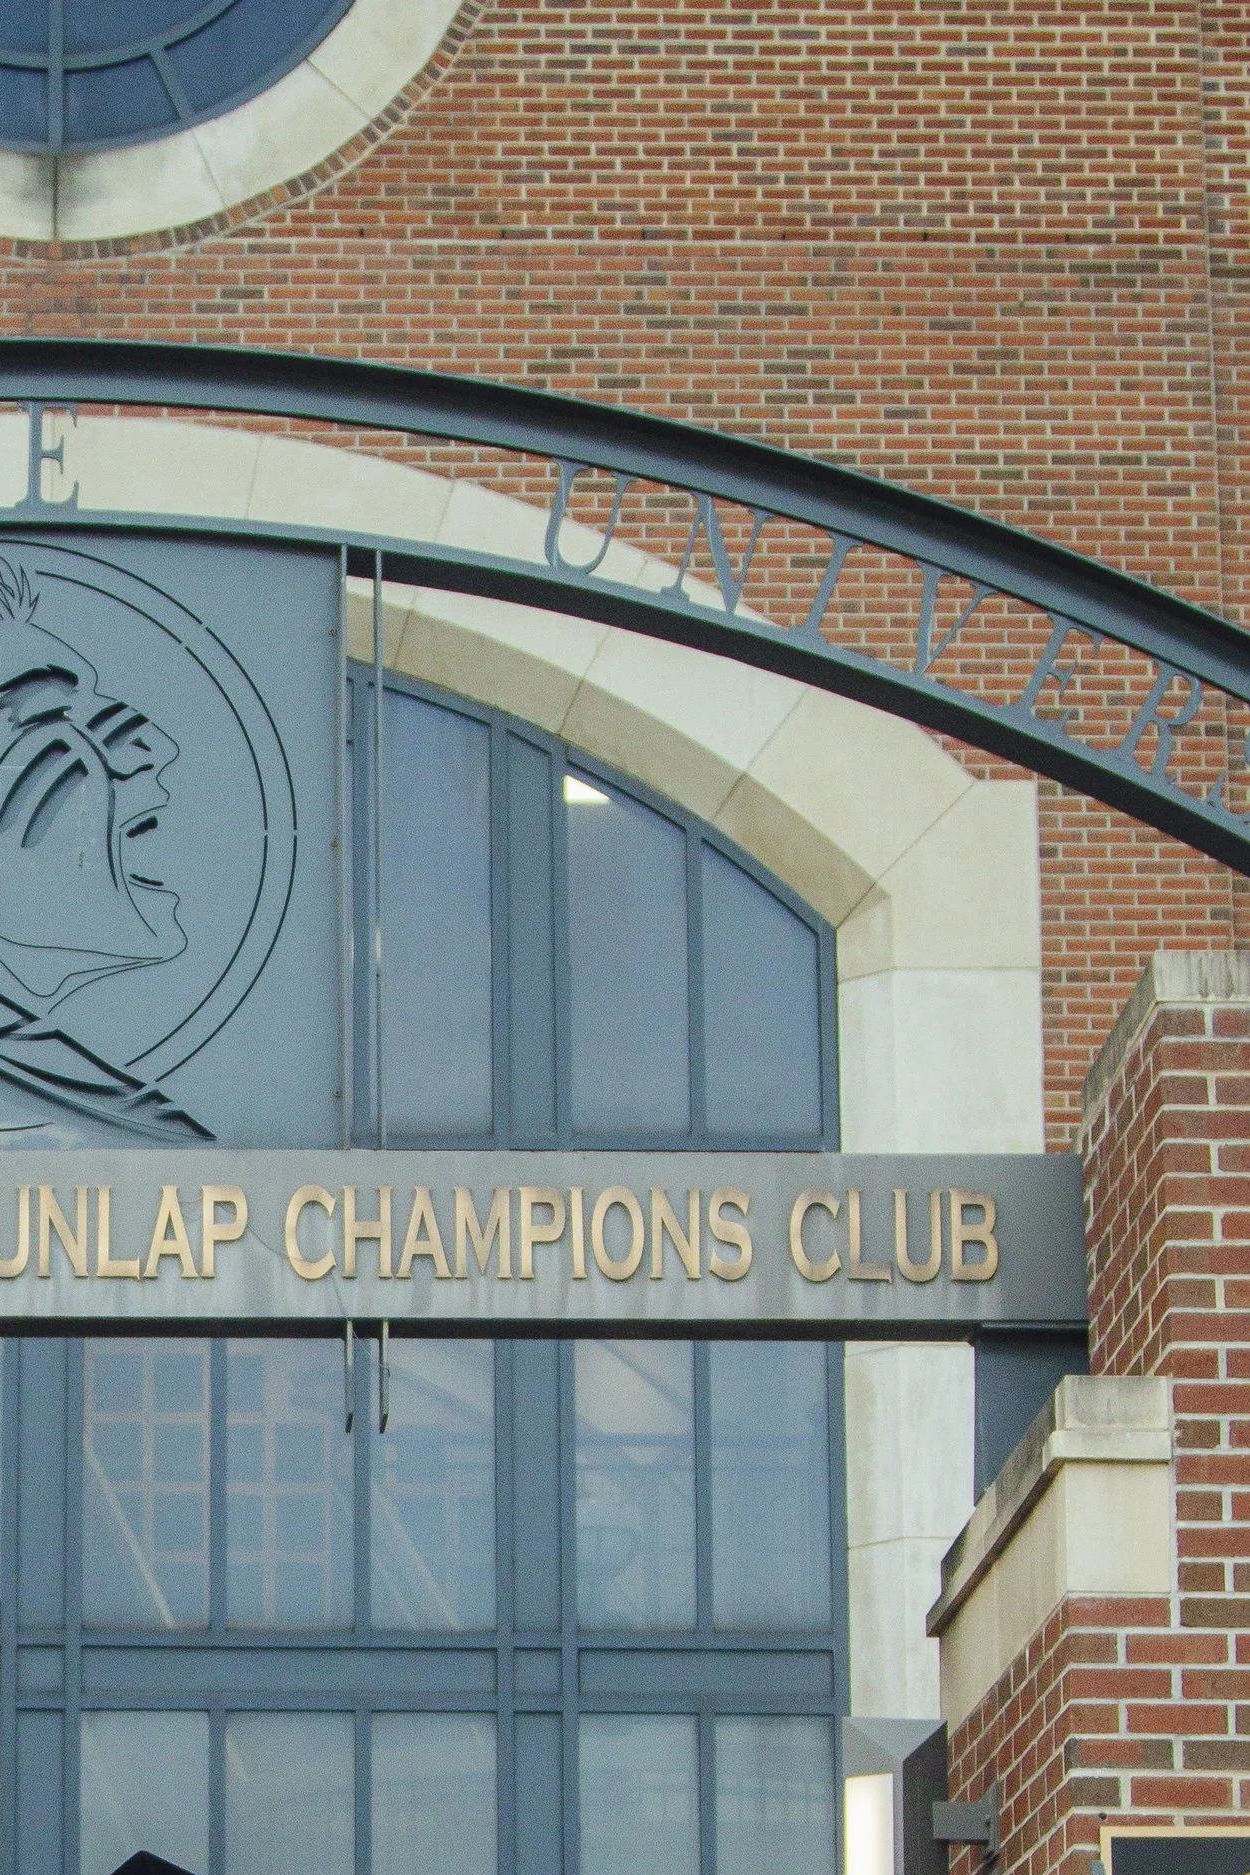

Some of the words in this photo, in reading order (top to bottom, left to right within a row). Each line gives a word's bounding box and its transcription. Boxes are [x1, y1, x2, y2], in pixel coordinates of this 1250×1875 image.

[544, 457, 1250, 826] UNIVER
[284, 1184, 753, 1281] CHAMPIONS
[789, 1187, 999, 1283] CLUB
